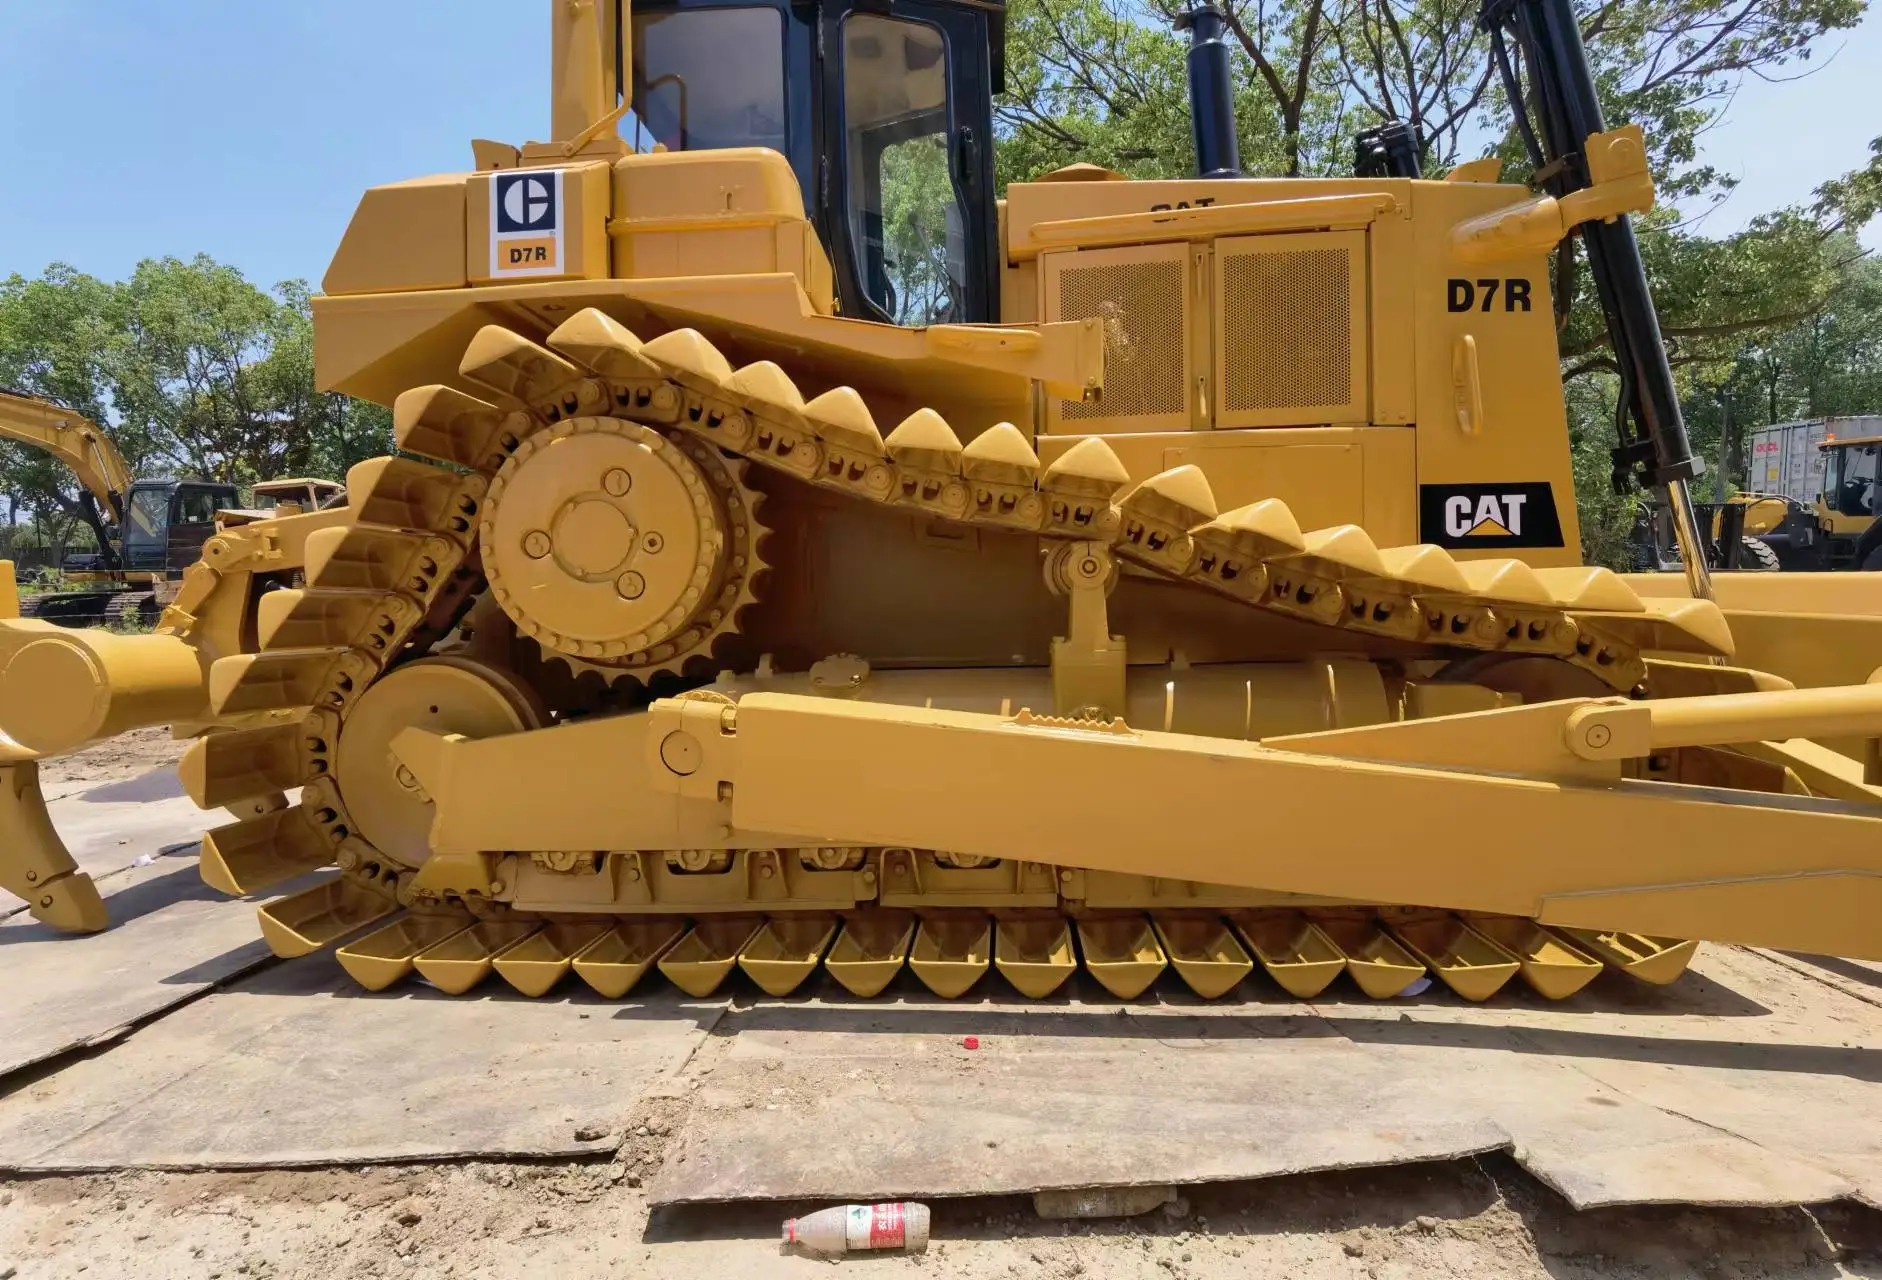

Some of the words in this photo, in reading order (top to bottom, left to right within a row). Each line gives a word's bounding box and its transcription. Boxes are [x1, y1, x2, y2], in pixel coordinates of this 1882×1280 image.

[509, 246, 547, 264] D7R
[1447, 278, 1531, 313] D7R
[1445, 493, 1527, 538] CAT
